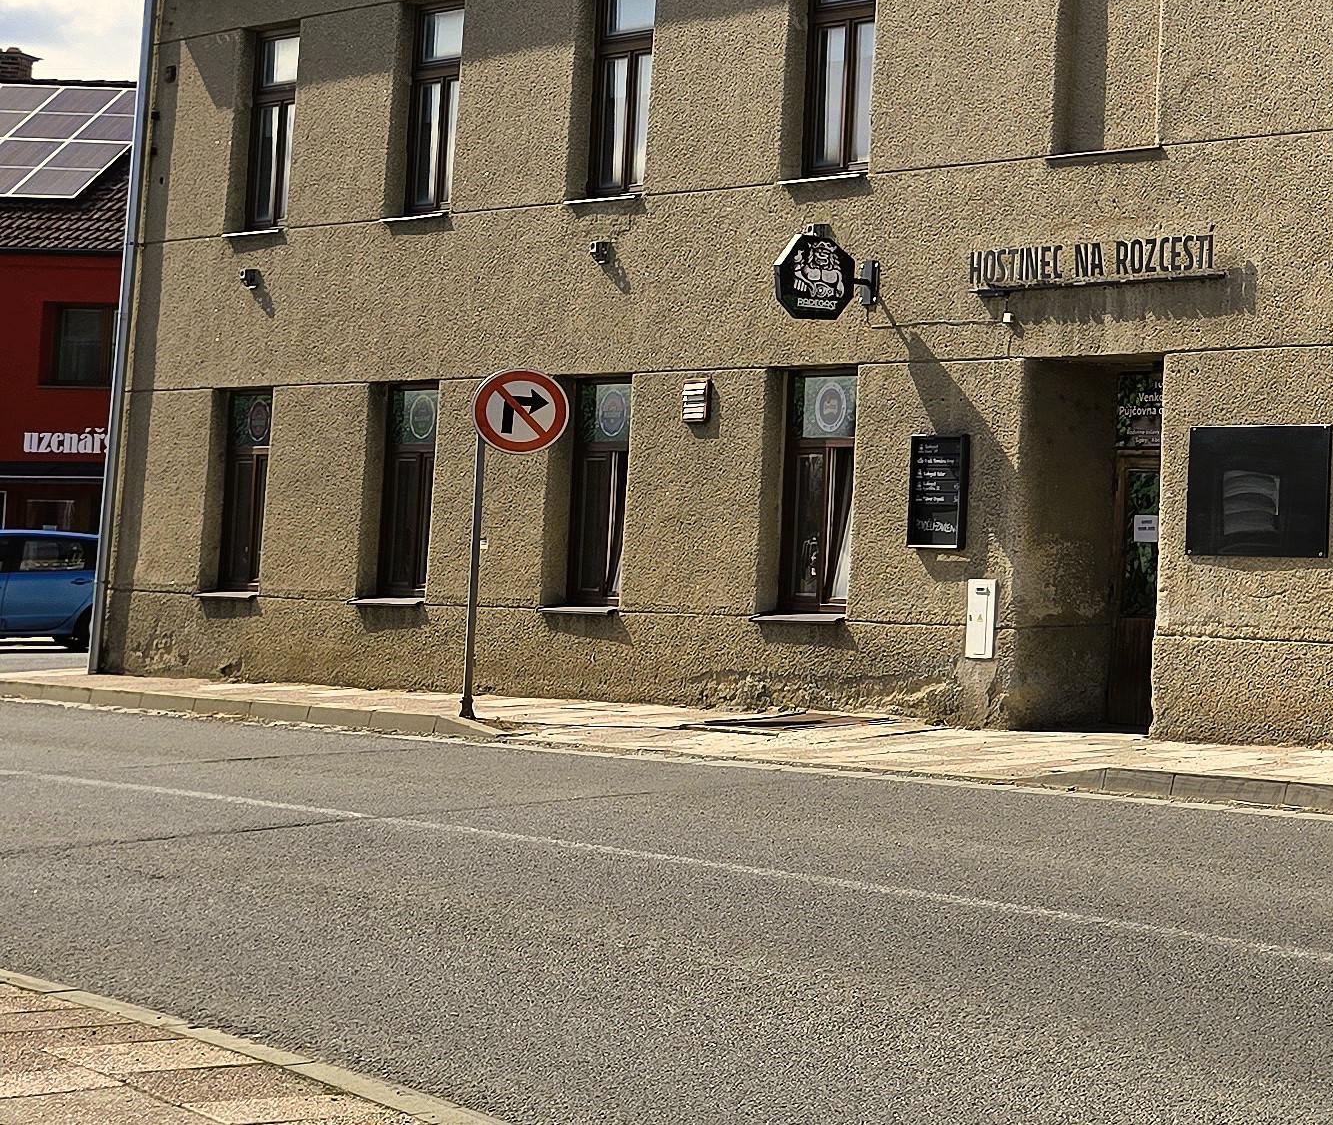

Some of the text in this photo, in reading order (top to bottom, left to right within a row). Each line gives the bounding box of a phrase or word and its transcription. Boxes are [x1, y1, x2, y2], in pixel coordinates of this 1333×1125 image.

[969, 224, 1216, 284] HOSTINEC NA ROZCESTÍ
